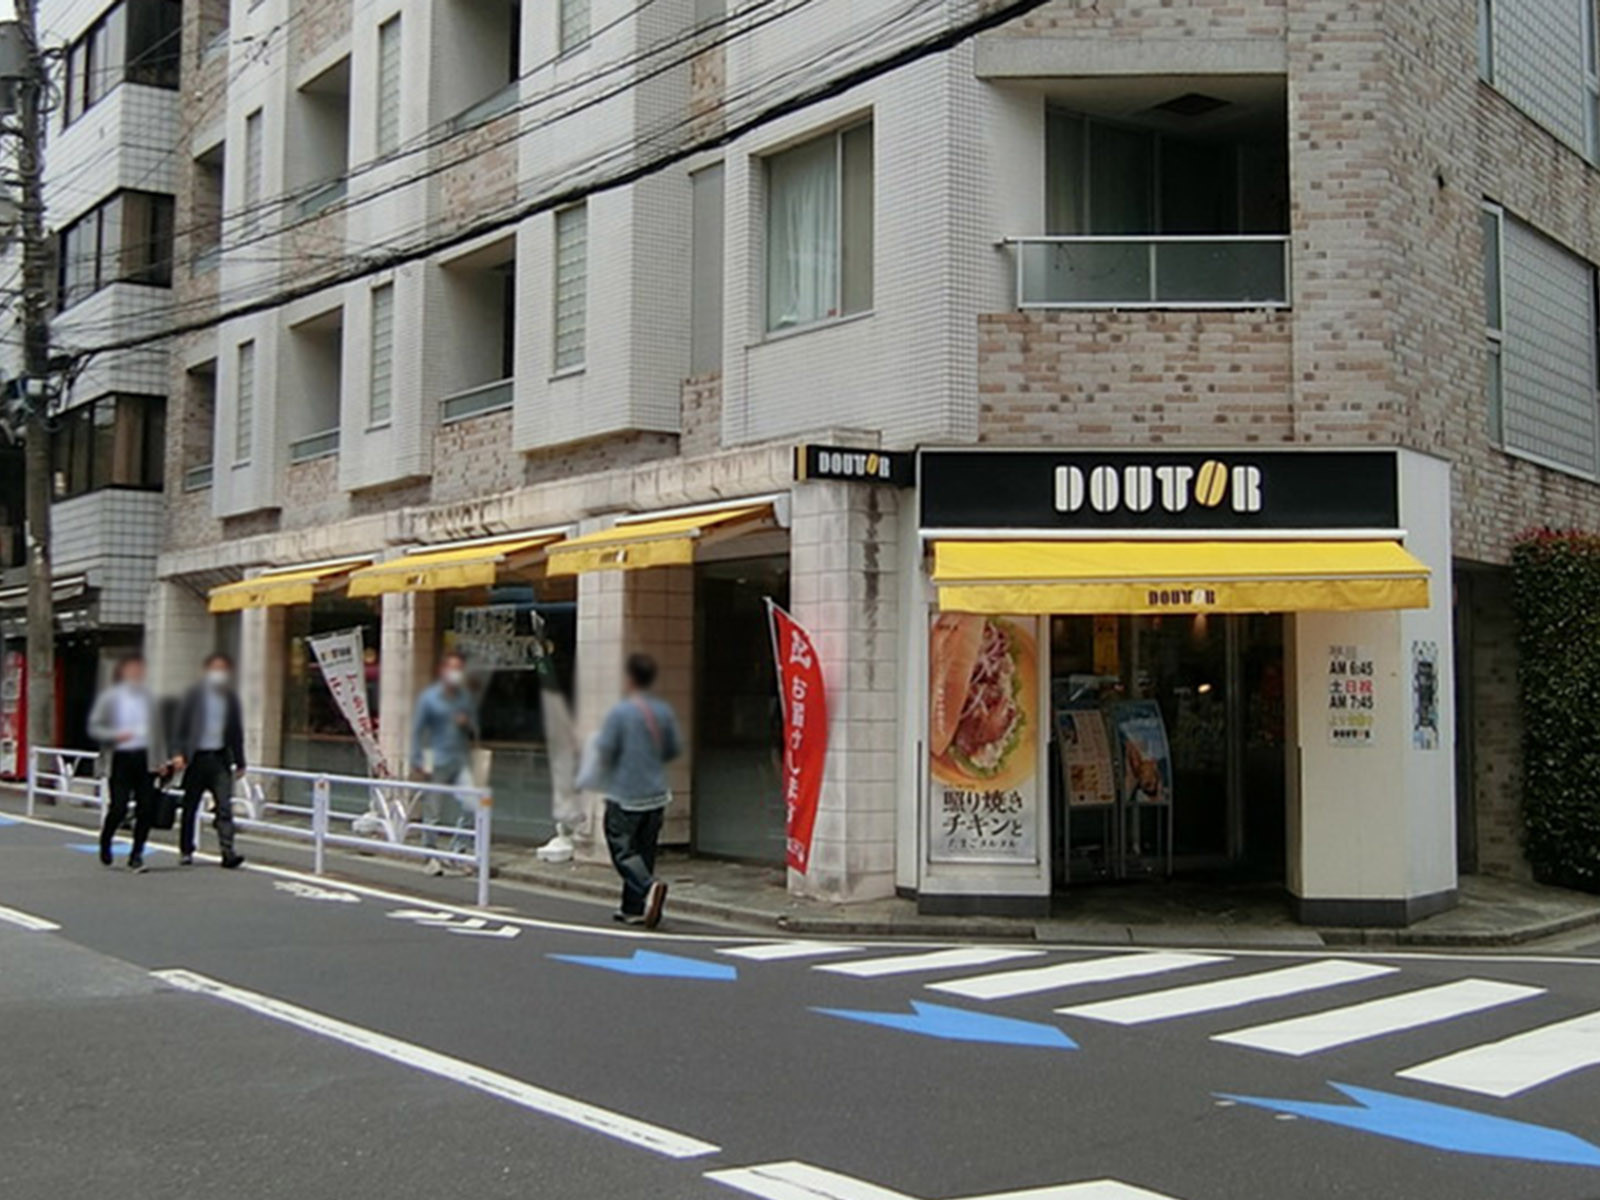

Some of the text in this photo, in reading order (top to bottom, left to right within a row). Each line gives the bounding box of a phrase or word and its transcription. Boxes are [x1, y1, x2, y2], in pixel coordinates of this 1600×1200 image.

[818, 452, 891, 478] DOUTOR
[1054, 460, 1262, 512] DOUTOR
[1148, 588, 1216, 606] DOUTOR
[1329, 661, 1347, 675] AM
[1329, 695, 1347, 709] AM
[942, 790, 1023, 814] 照り焼き
[942, 813, 1023, 837] チキンと
